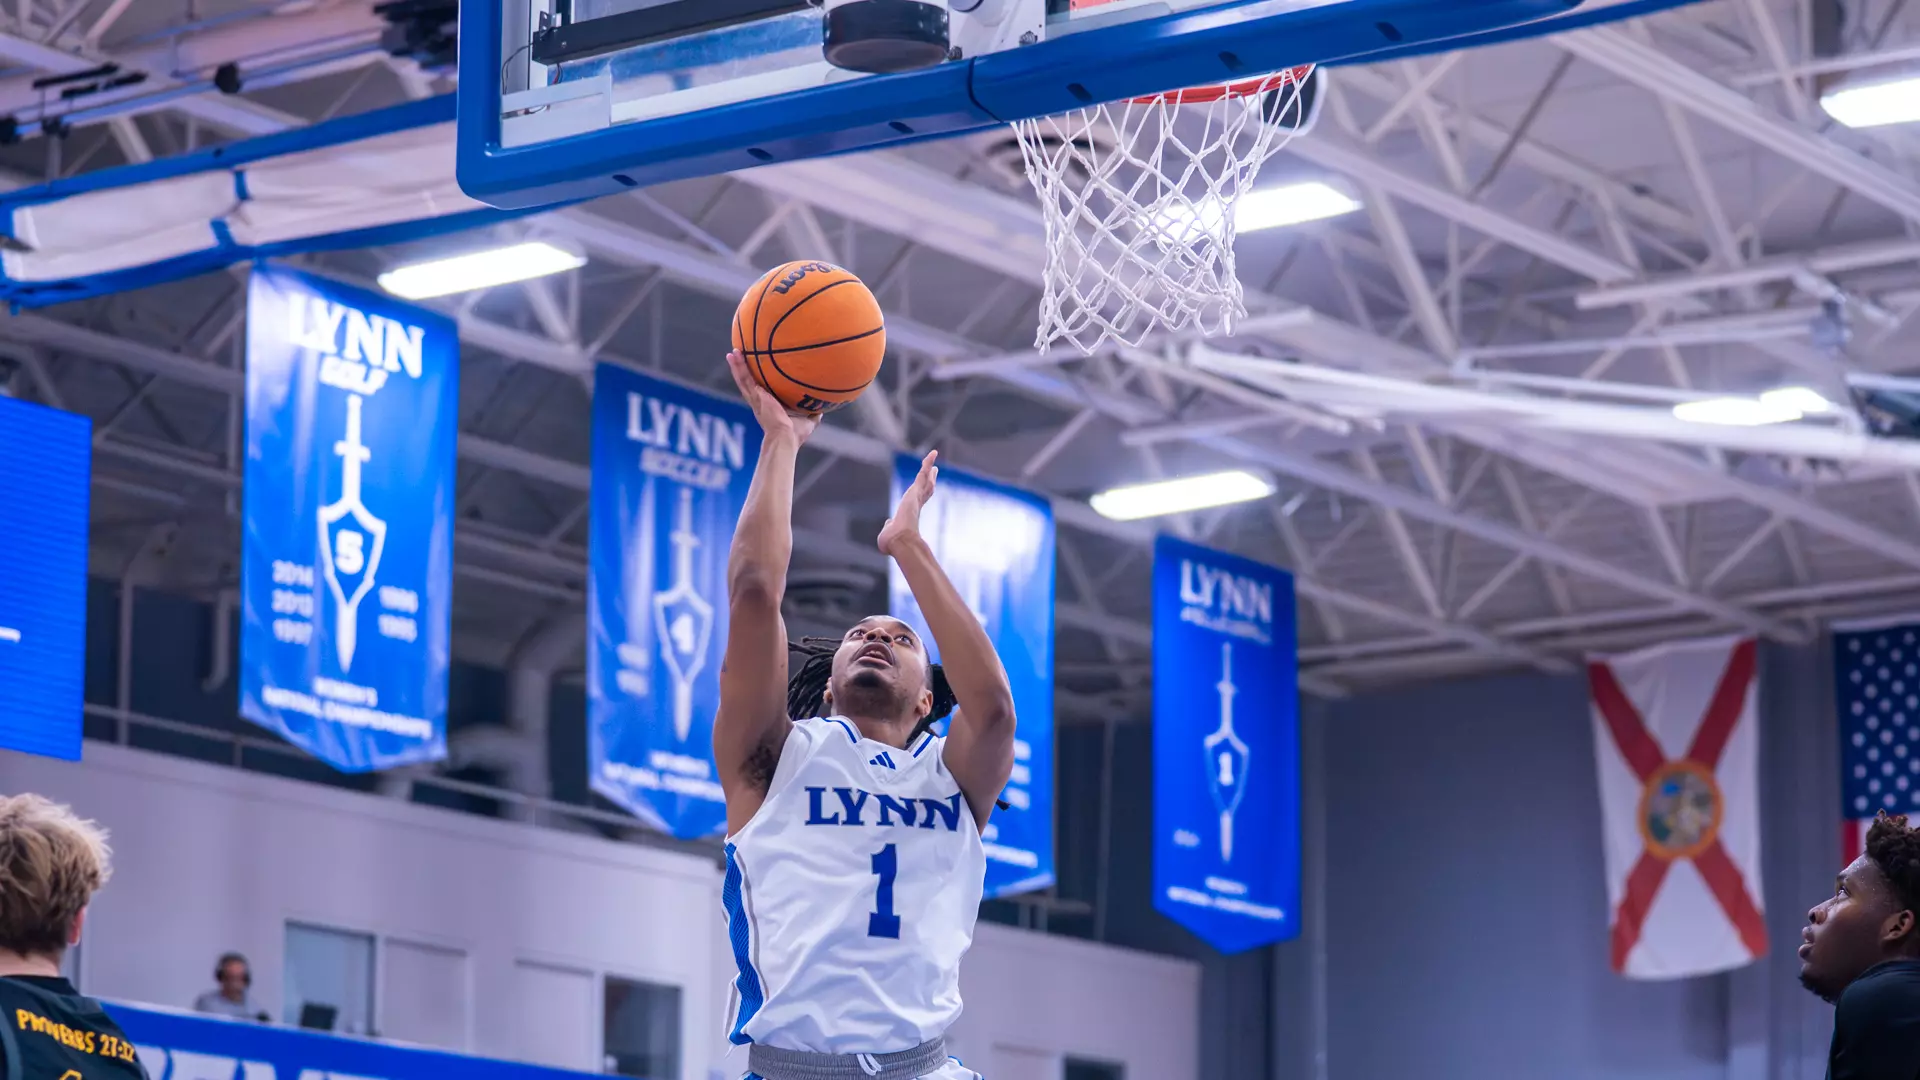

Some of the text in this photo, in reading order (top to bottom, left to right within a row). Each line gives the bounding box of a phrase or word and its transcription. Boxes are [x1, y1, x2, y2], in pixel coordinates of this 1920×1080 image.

[287, 291, 424, 379] LYNN
[626, 390, 746, 471] LYNN
[335, 528, 364, 574] 5
[1179, 558, 1272, 624] LYNN
[804, 786, 961, 832] LYNN
[867, 843, 901, 940] 1
